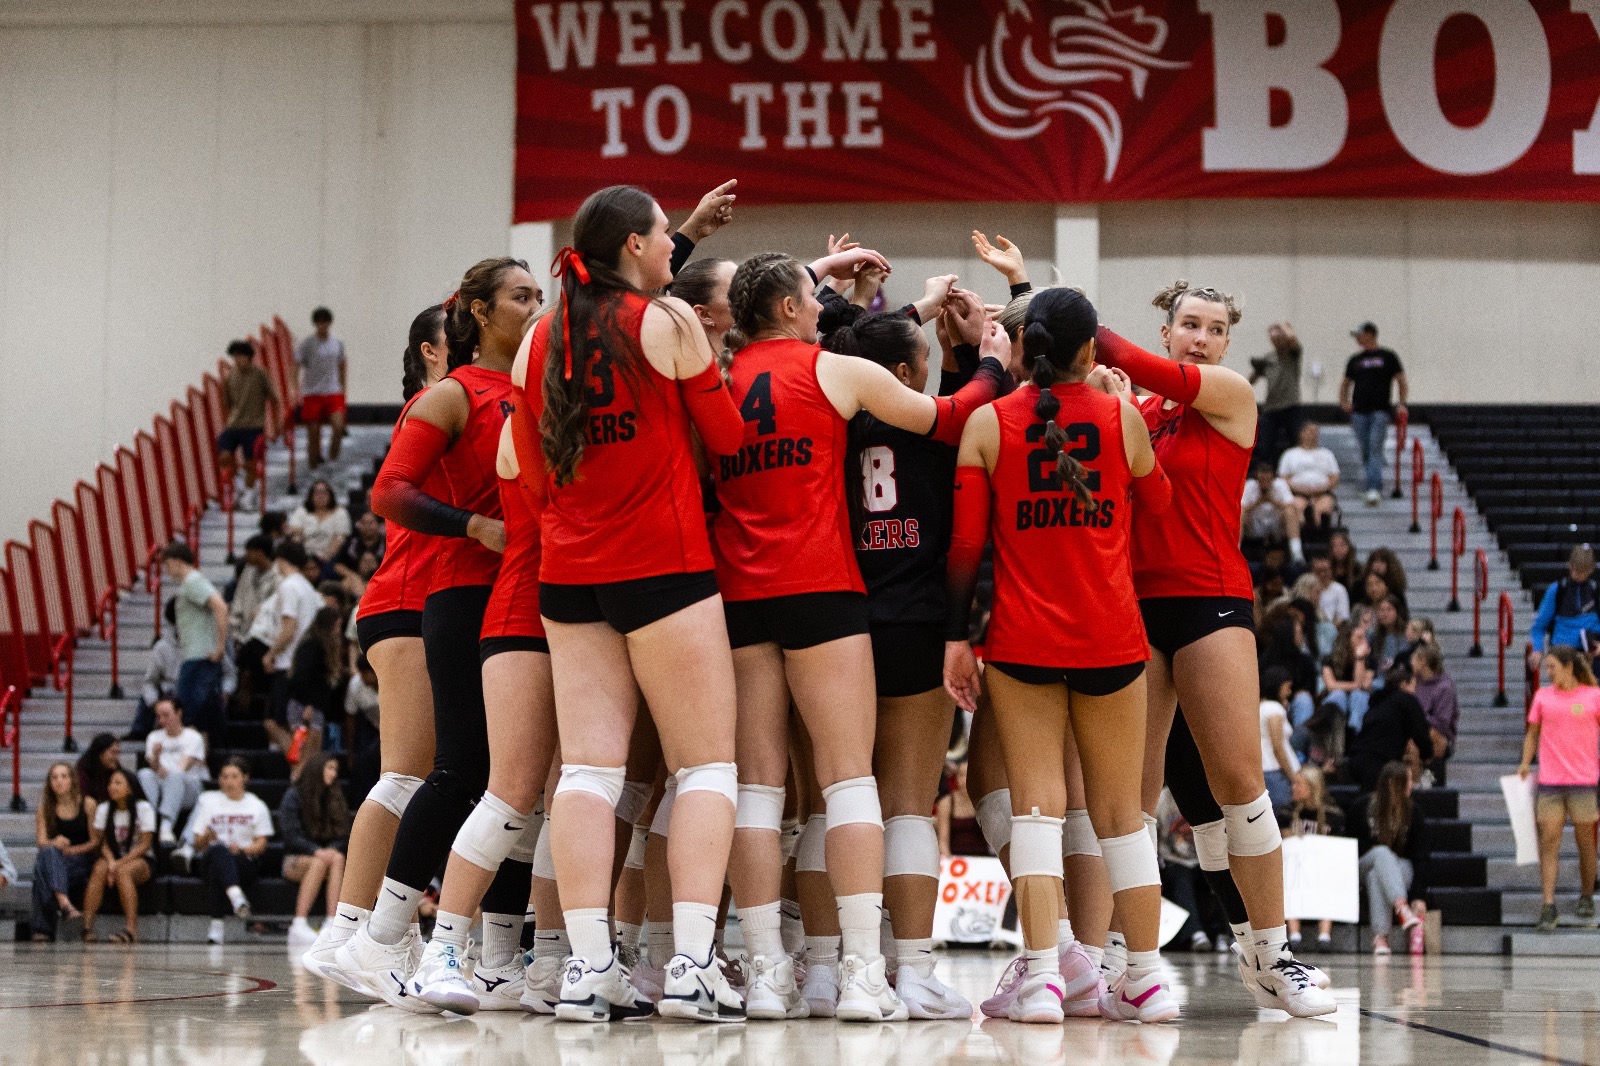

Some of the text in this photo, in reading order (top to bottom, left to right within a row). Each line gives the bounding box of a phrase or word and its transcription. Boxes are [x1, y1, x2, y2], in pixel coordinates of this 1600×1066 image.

[532, 0, 938, 71] WELCOME
[591, 81, 884, 158] TO THE
[585, 411, 637, 447] ERS
[739, 369, 776, 436] 4
[719, 437, 814, 482] BOXERS
[1025, 422, 1101, 493] 22
[1016, 498, 1115, 531] BOXERS
